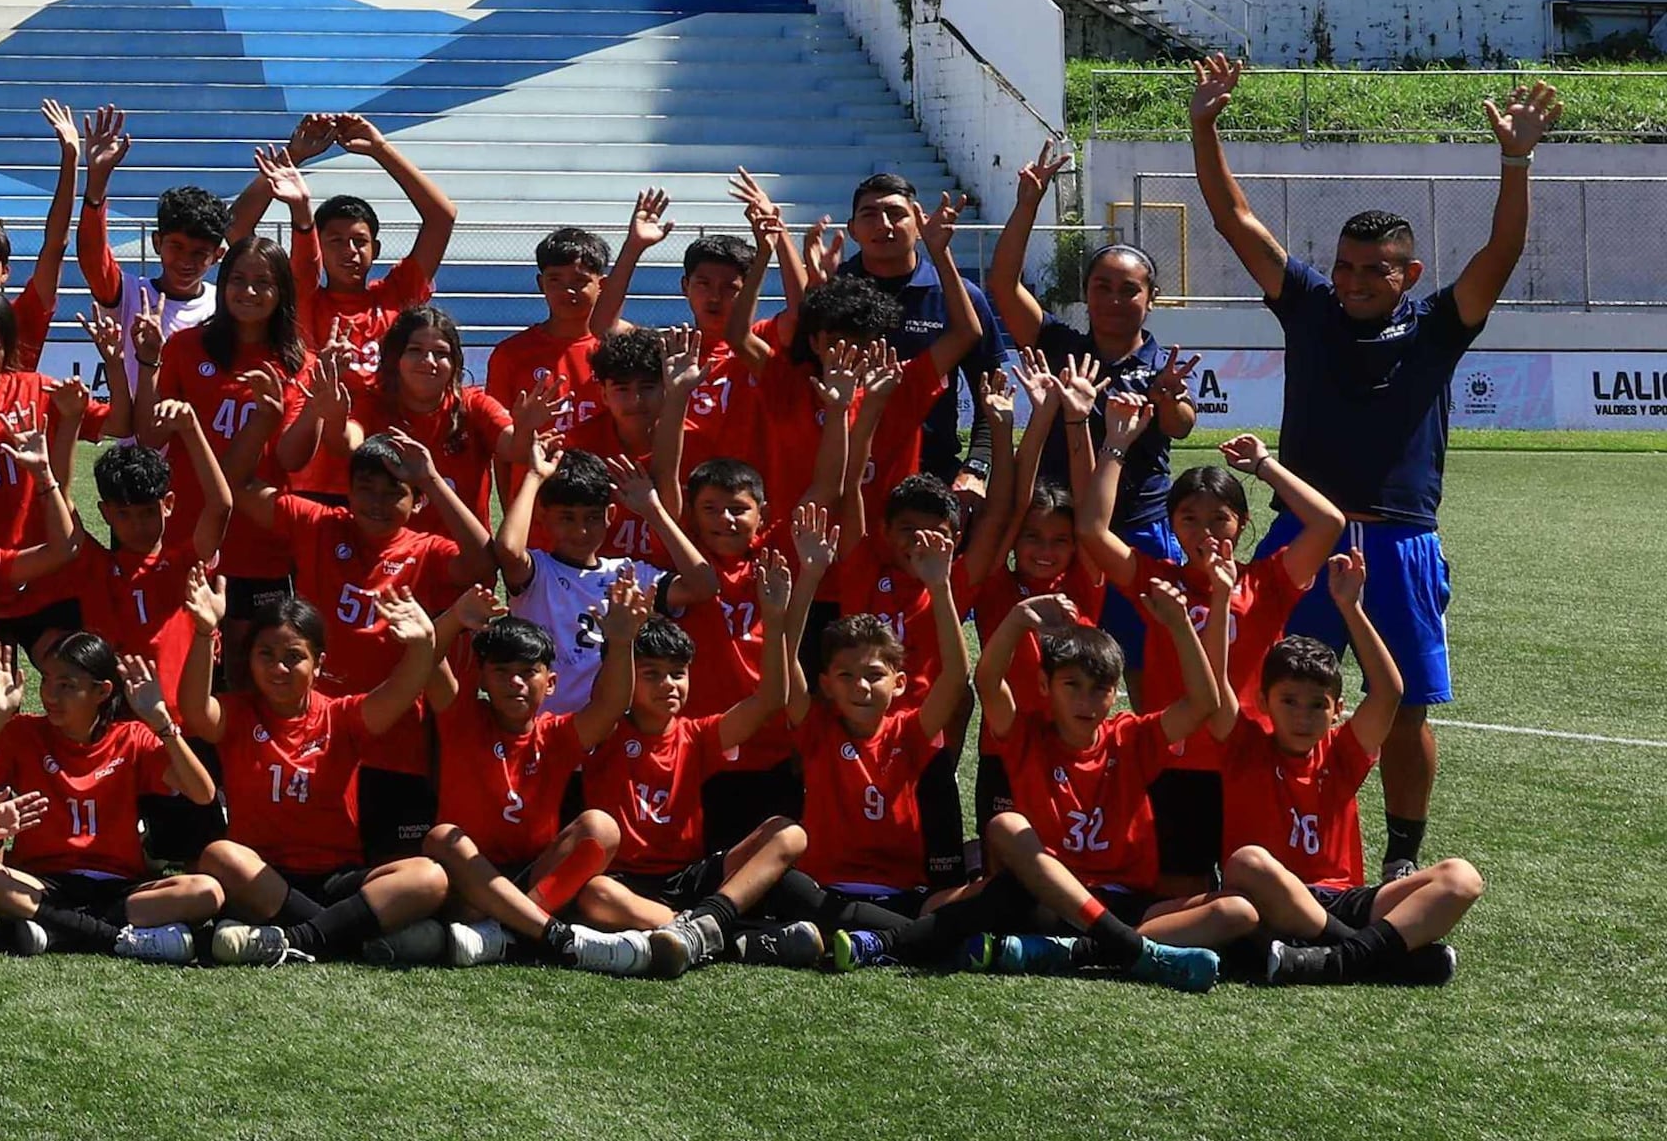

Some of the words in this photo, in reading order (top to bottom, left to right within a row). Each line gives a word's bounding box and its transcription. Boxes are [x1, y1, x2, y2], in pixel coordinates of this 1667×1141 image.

[1595, 405, 1637, 415] VALORES
[133, 589, 148, 625] 1
[269, 764, 309, 804] 14
[67, 798, 97, 836] 11
[503, 790, 524, 824] 2
[864, 785, 886, 821] 9
[1063, 807, 1109, 851] 32
